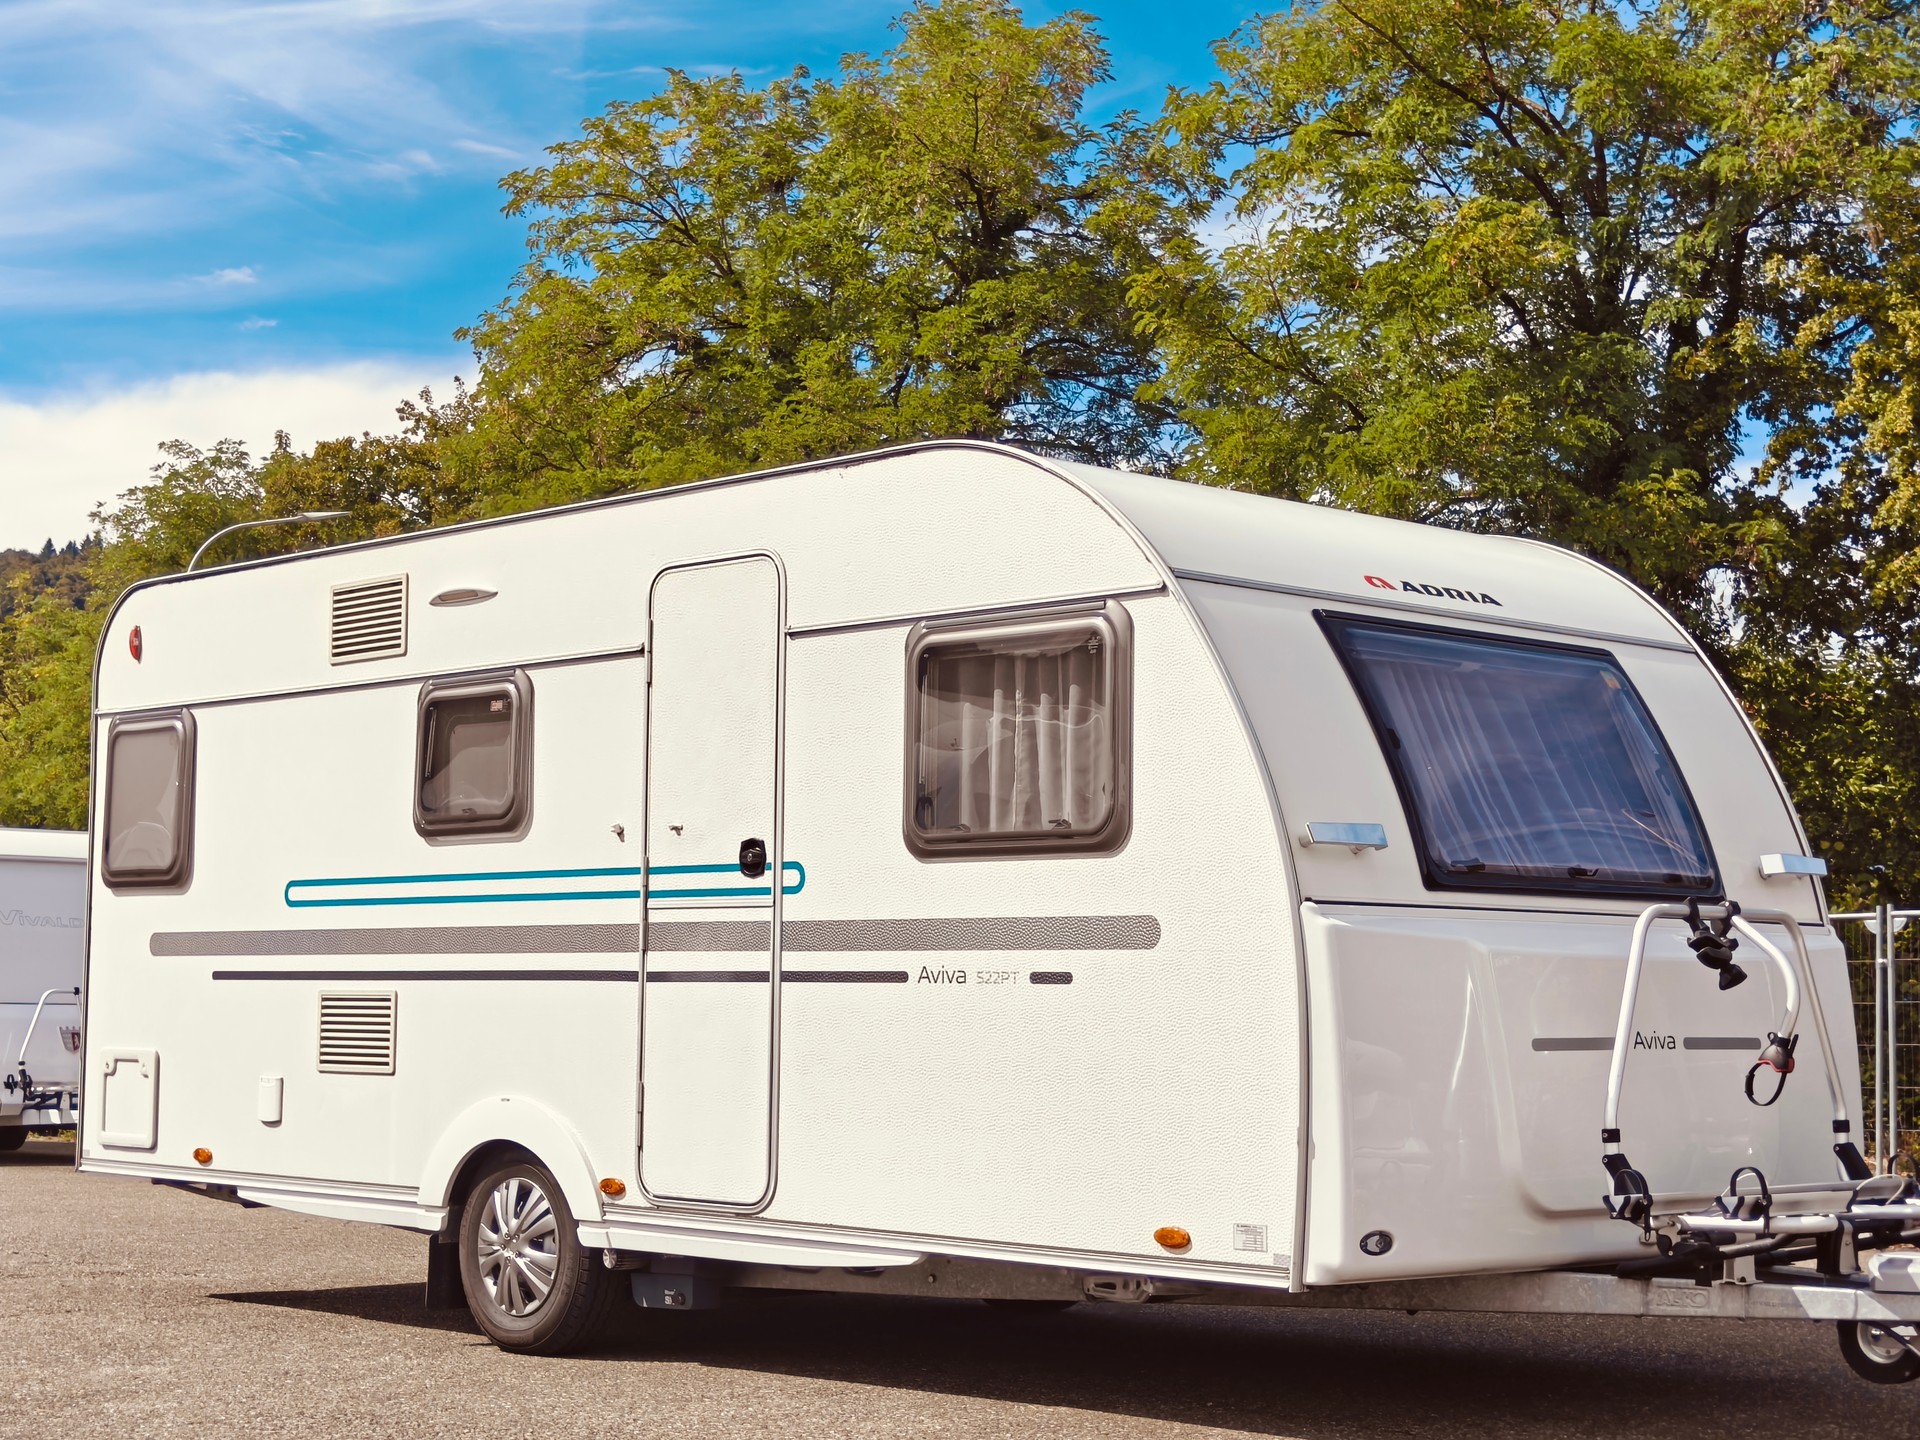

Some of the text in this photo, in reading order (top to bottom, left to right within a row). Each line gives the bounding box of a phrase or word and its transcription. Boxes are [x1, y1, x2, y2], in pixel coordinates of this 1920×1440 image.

[1400, 580, 1503, 607] ADRIA
[917, 965, 1019, 984] Aviva 522PT
[1633, 1030, 1676, 1050] Aviva
